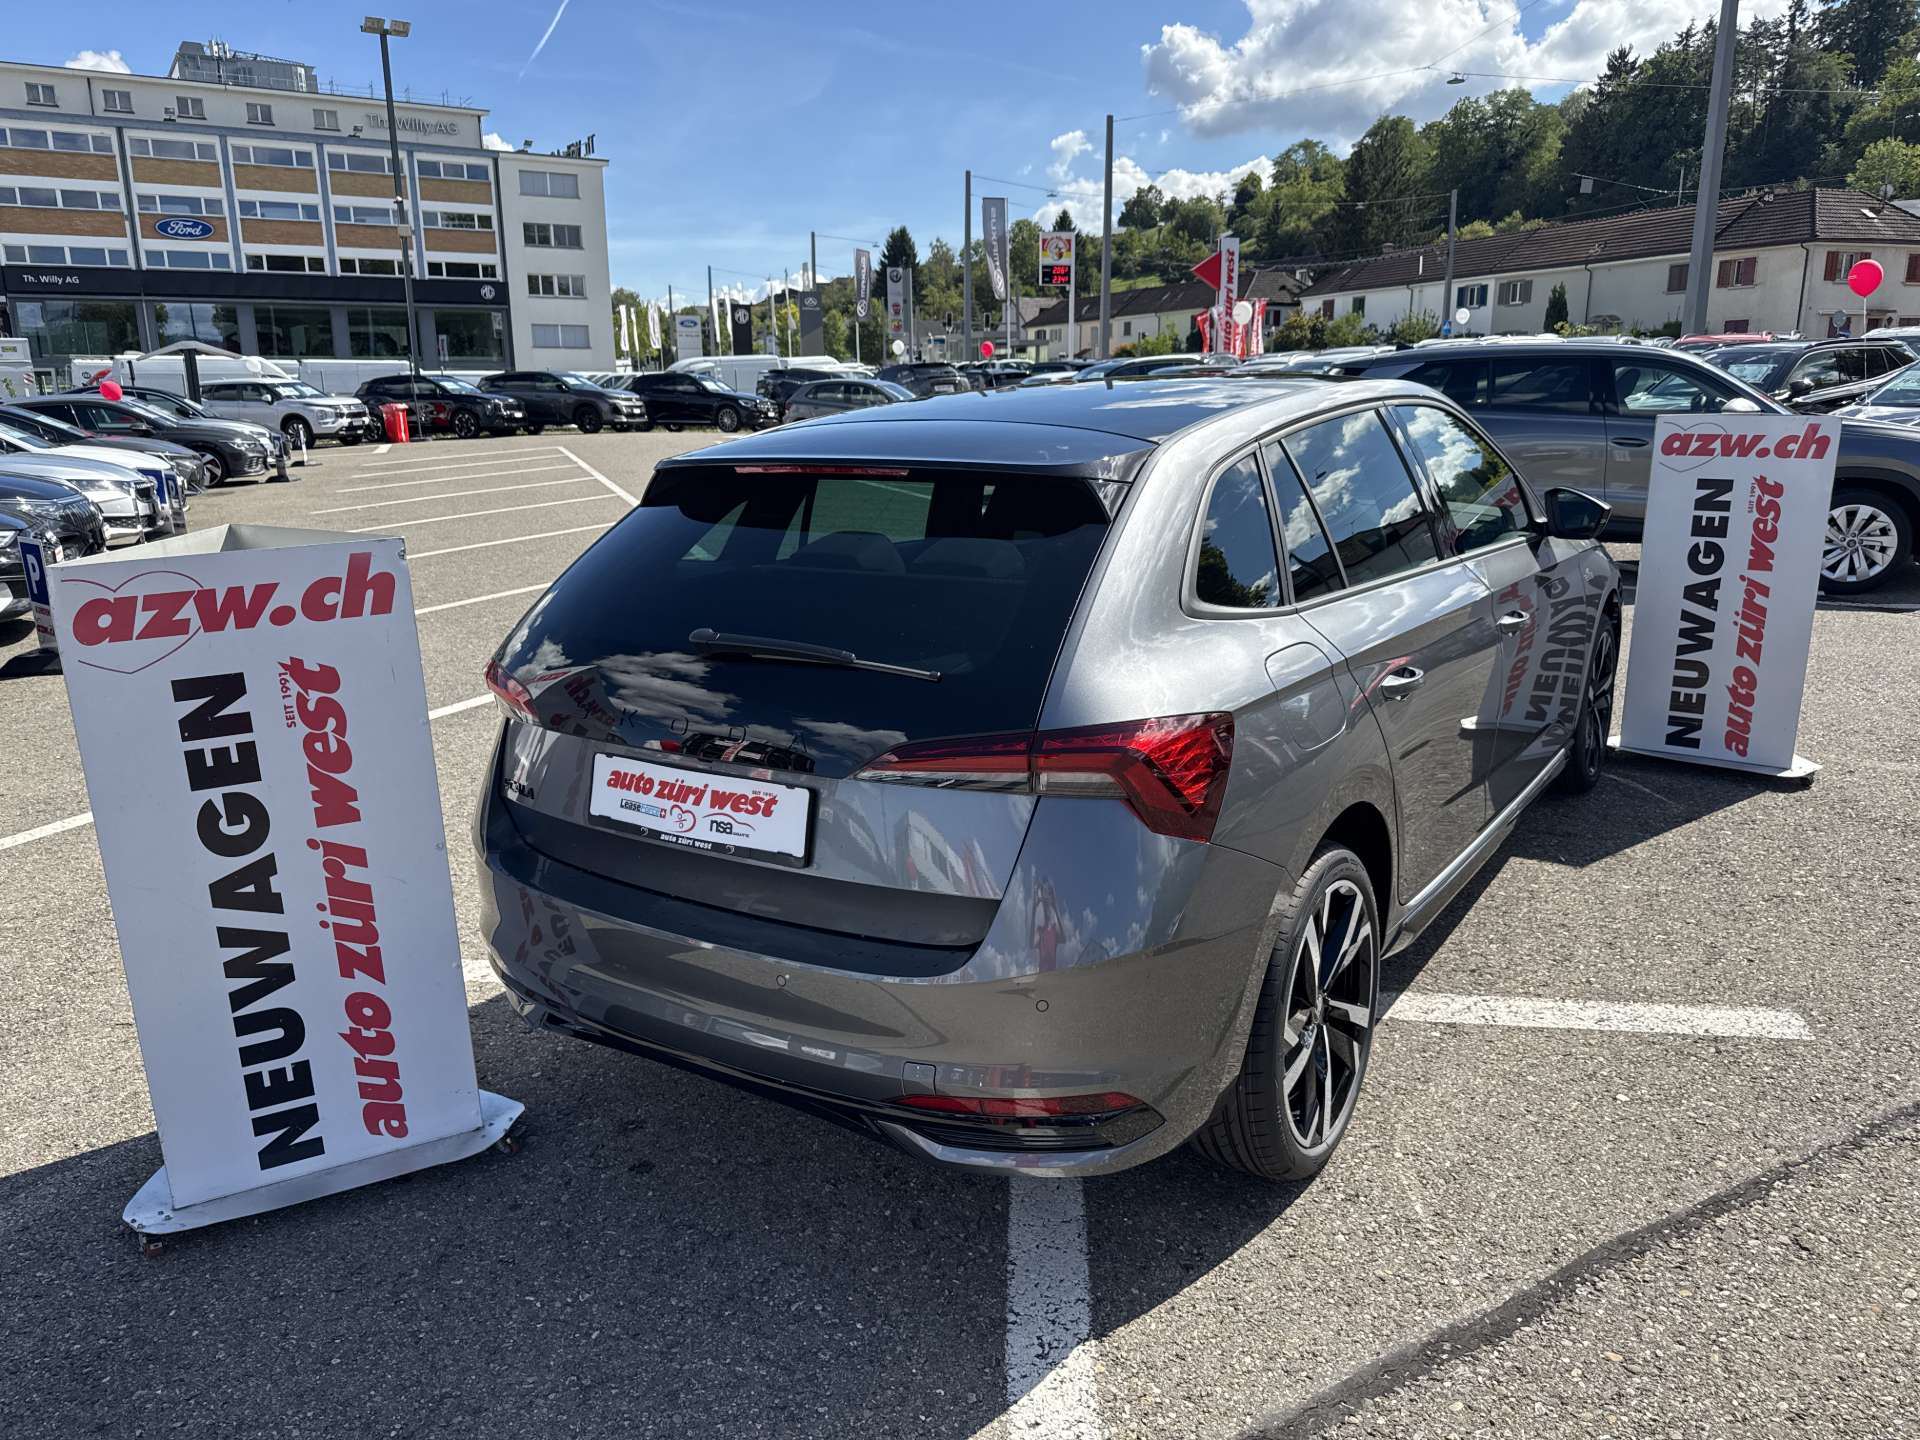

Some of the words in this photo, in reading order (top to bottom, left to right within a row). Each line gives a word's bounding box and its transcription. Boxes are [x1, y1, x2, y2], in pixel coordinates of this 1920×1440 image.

[394, 118, 430, 137] Willy
[433, 122, 458, 136] AG
[167, 220, 202, 236] Ford
[22, 274, 38, 283] Th.
[39, 275, 63, 285] Willy
[65, 276, 80, 284] AG
[480, 284, 496, 300] MG
[1661, 423, 1832, 460] azw.ch
[1747, 475, 1784, 572] west
[26, 554, 41, 595] P
[72, 552, 396, 645] azw.ch
[1664, 478, 1735, 750] NEUWAGEN
[1732, 574, 1772, 667] züri
[278, 672, 292, 700] 1991
[284, 704, 297, 729] SEIT
[1724, 665, 1759, 757] auto
[277, 656, 360, 829] west
[607, 769, 654, 796] auto
[655, 778, 709, 808] züri
[709, 789, 779, 818] west
[660, 833, 677, 843] auto
[677, 836, 694, 846] züri
[694, 840, 712, 850] west
[710, 819, 733, 835] nsa
[170, 671, 326, 1171] NEUWAGEN
[307, 838, 386, 985] züri
[338, 993, 408, 1139] auto
